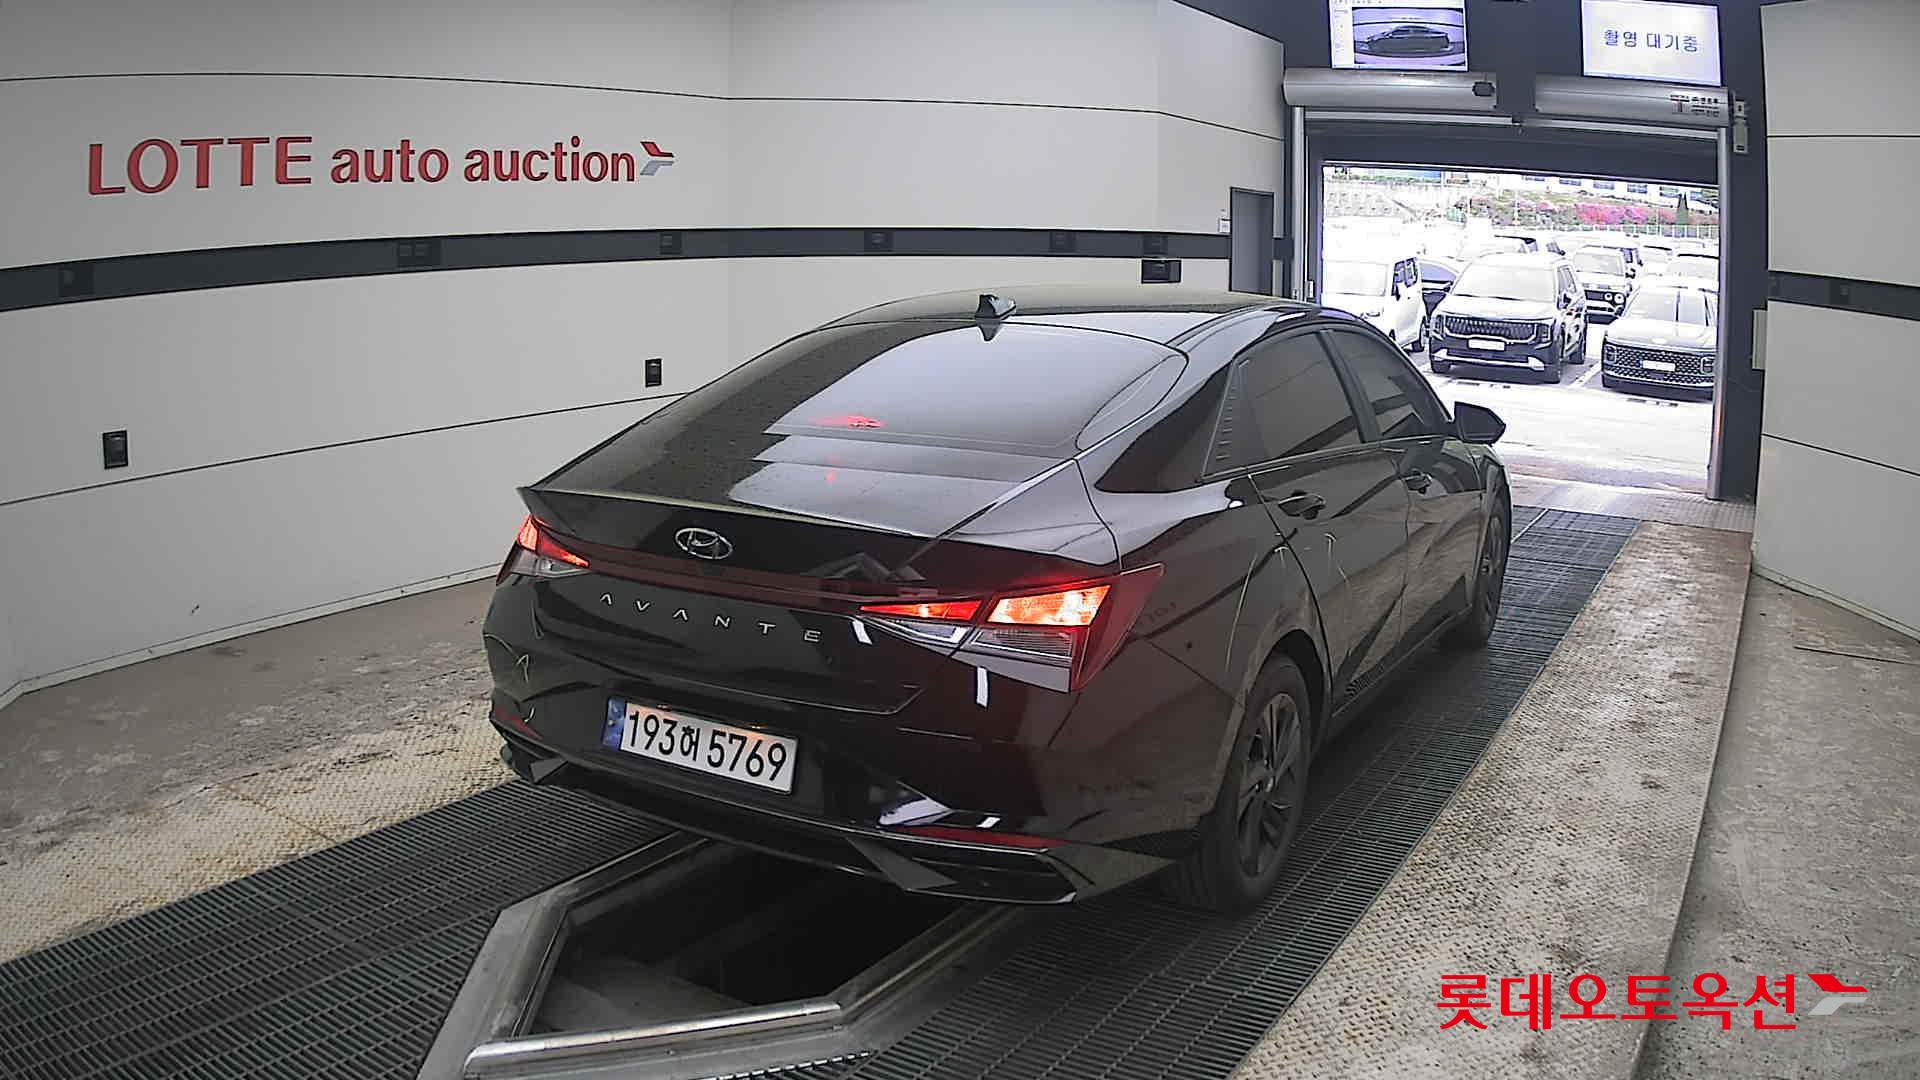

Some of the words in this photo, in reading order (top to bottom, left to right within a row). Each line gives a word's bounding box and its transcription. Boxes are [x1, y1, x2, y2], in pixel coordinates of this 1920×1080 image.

[1646, 33, 1698, 52] 대기중
[88, 136, 312, 195] LOTTE
[330, 138, 449, 184] auto
[463, 135, 635, 183] auction
[600, 593, 822, 643] AVANTE
[707, 729, 787, 781] 5769
